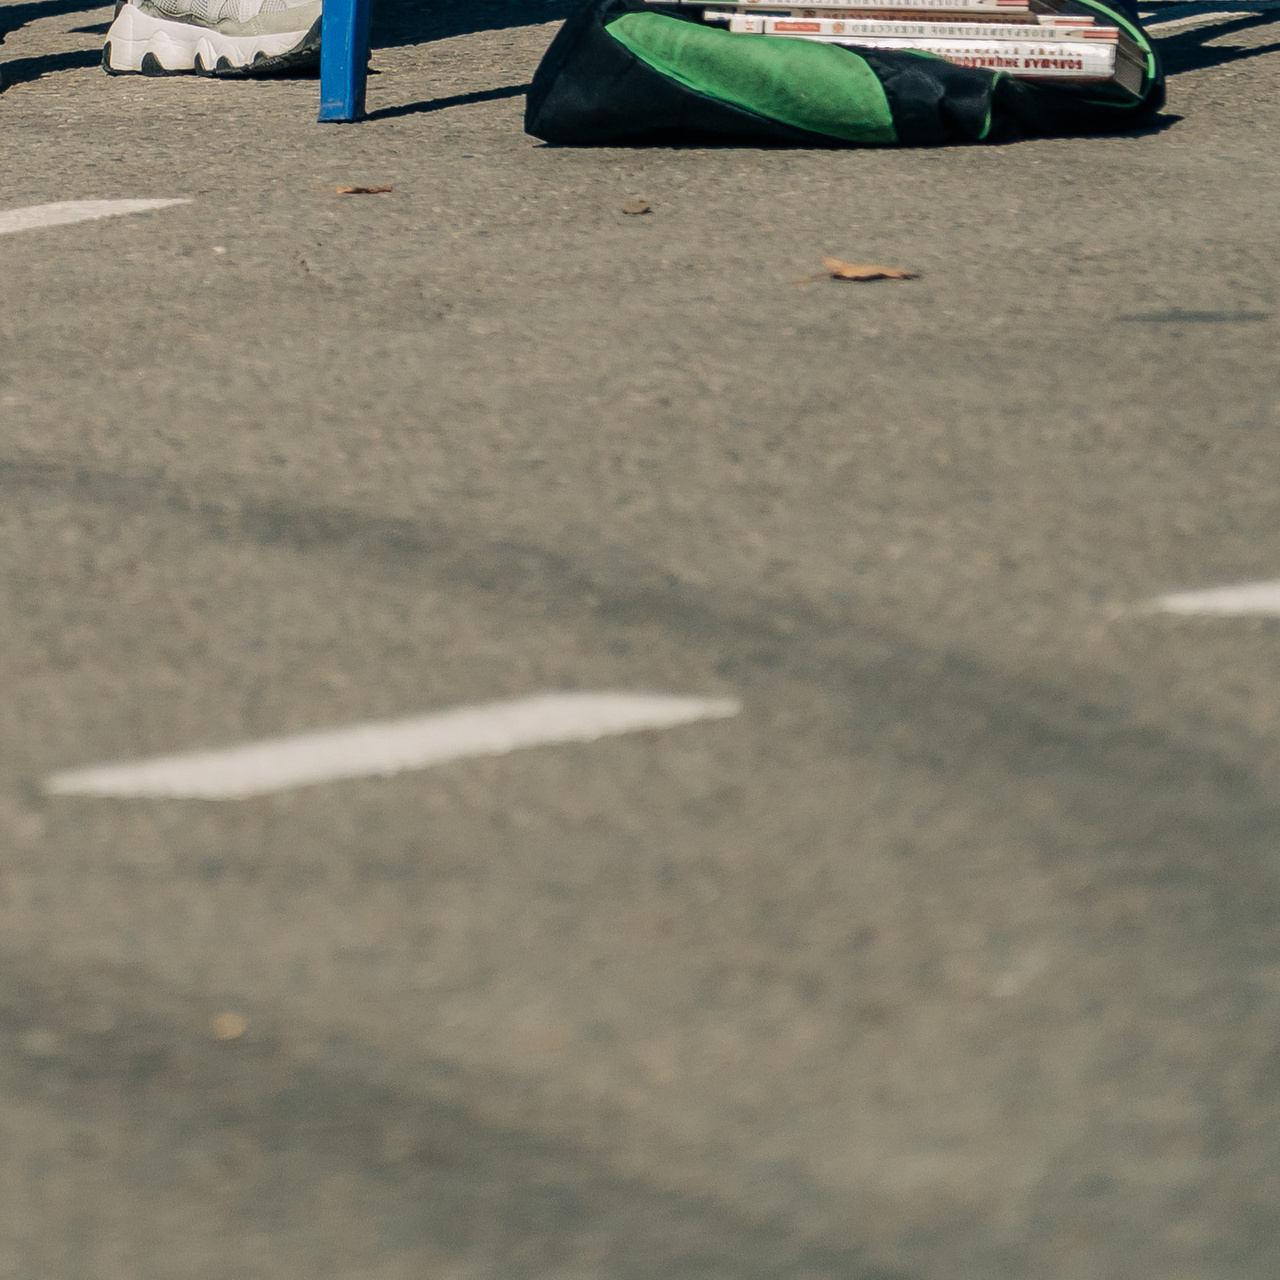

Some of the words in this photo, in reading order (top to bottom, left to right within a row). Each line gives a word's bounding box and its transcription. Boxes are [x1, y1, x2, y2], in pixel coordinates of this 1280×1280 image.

[852, 24, 926, 35] ИСКУССТВО
[930, 26, 1056, 38] ИЗОБРАЗИТЕЛЬНОЕ
[1024, 58, 1083, 70] БОЛЬШАЯ
